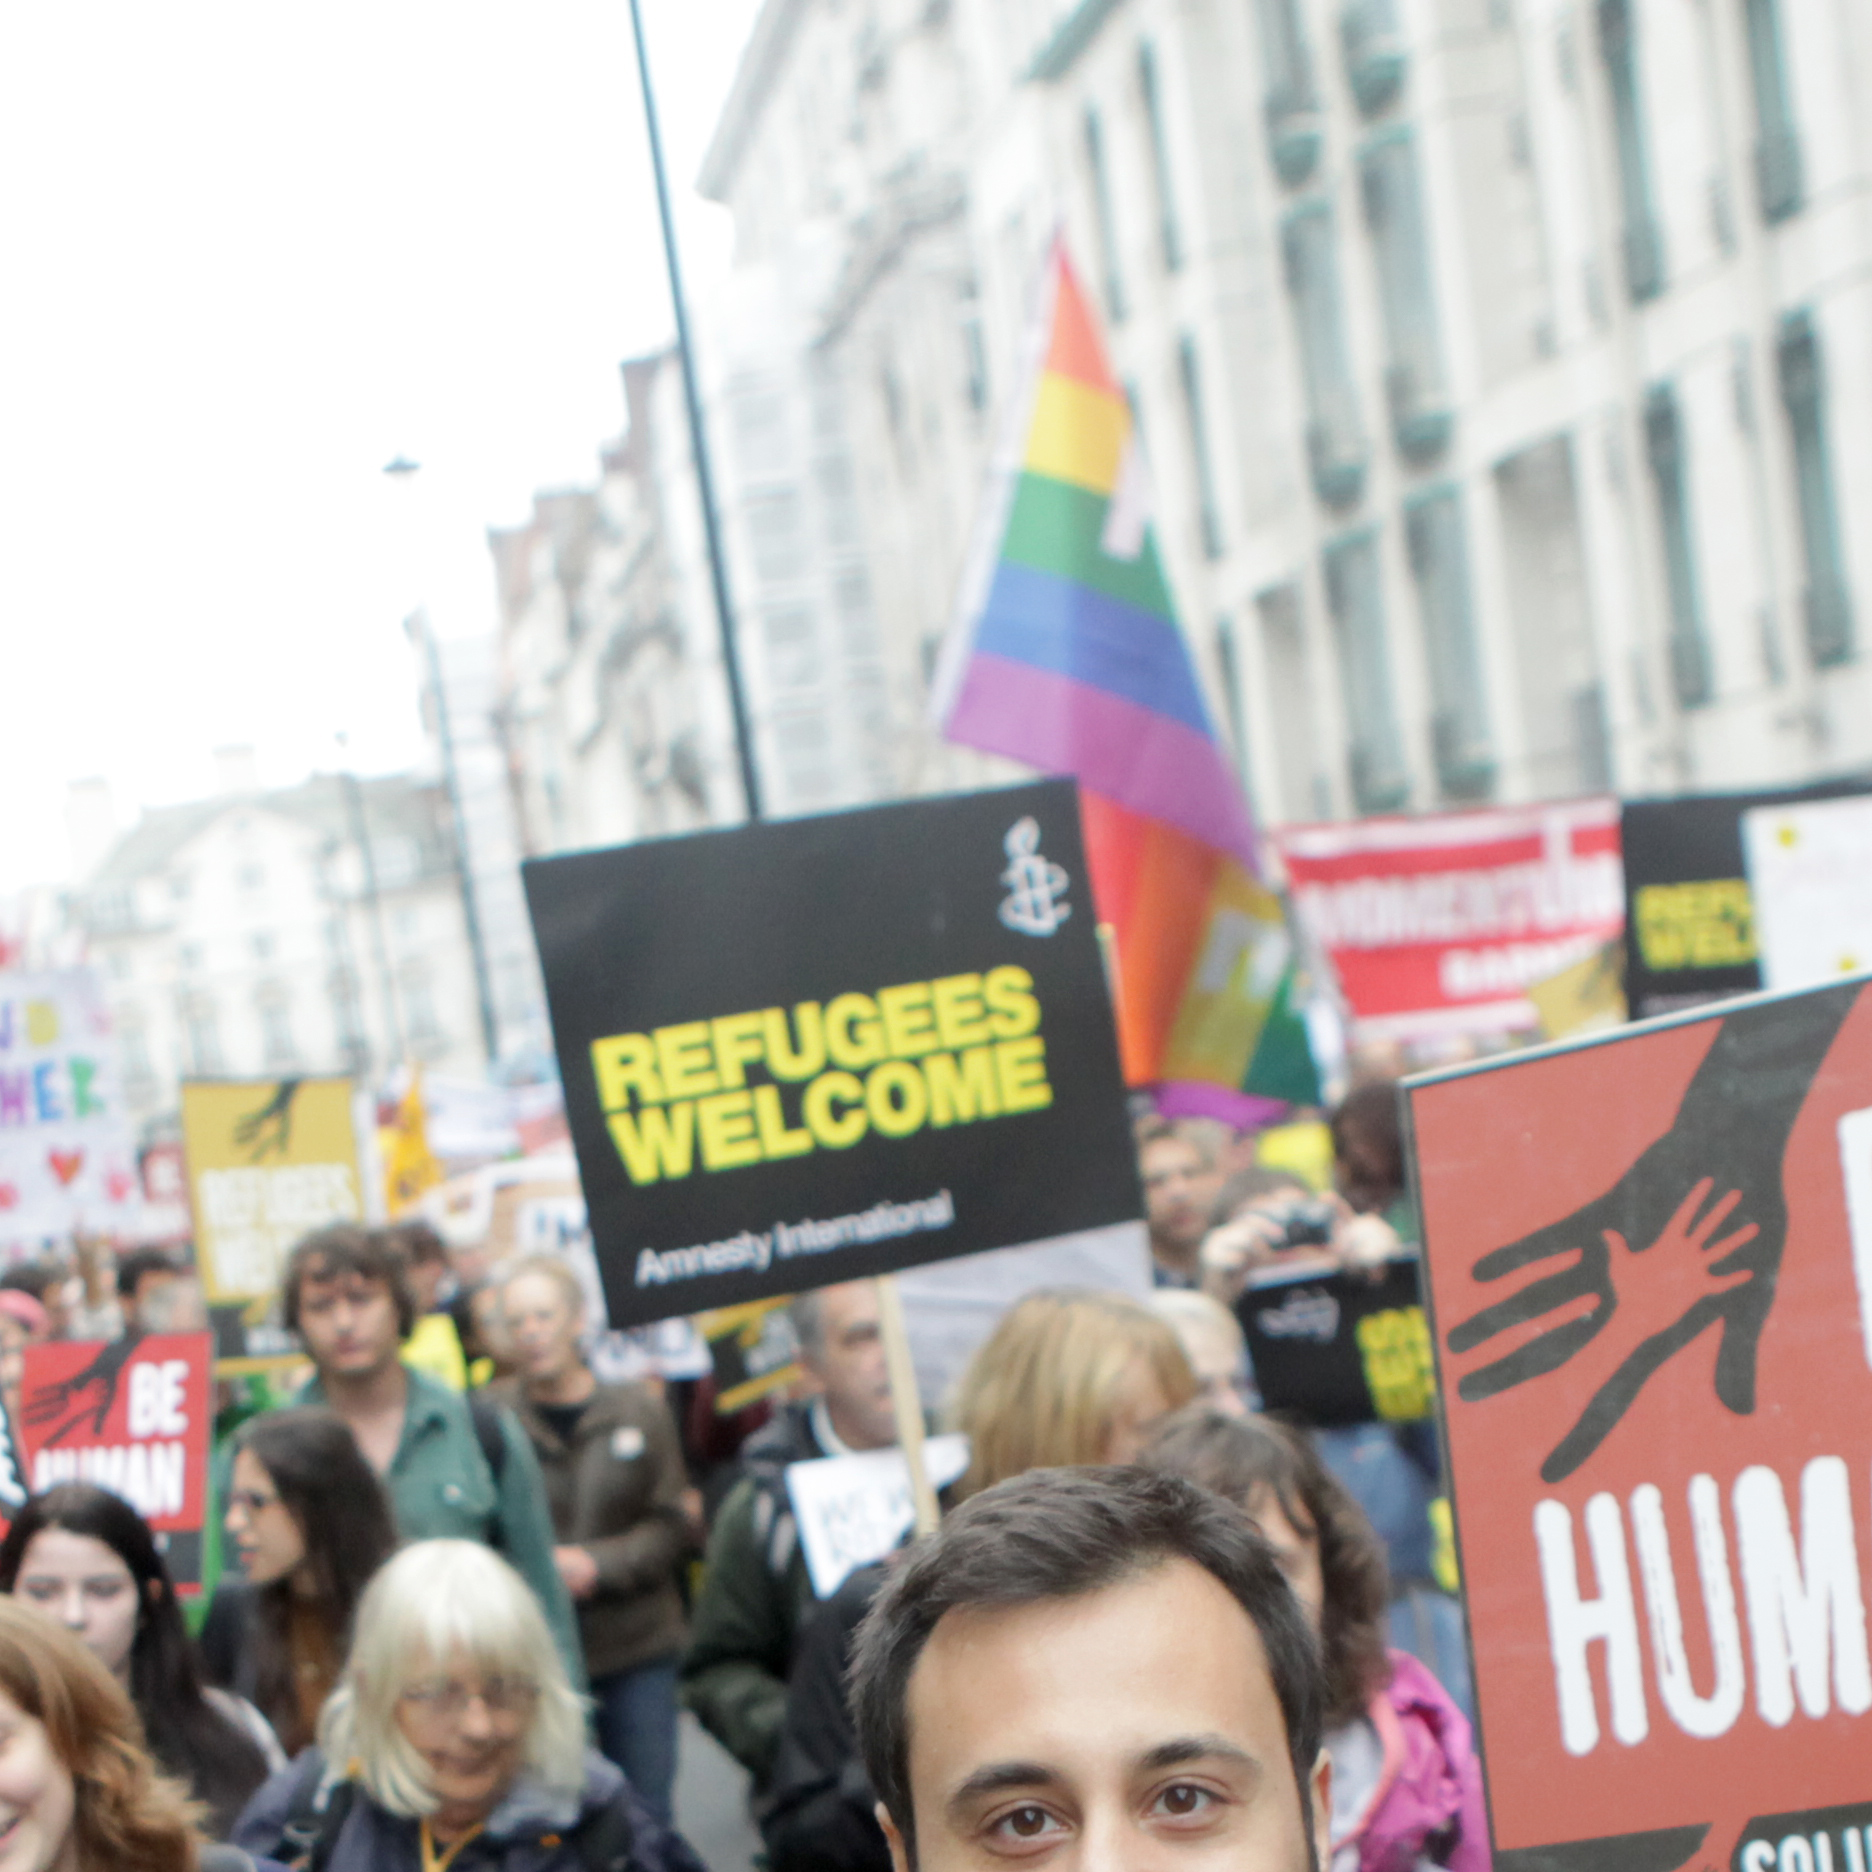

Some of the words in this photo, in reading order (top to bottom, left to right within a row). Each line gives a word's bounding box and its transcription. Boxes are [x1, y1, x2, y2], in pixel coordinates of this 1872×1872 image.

[590, 965, 1041, 1112] REFUGEES
[606, 1035, 1053, 1185] WELCOME
[634, 1229, 773, 1290] Amnesty
[773, 1189, 956, 1259] International
[129, 1359, 190, 1440] BE
